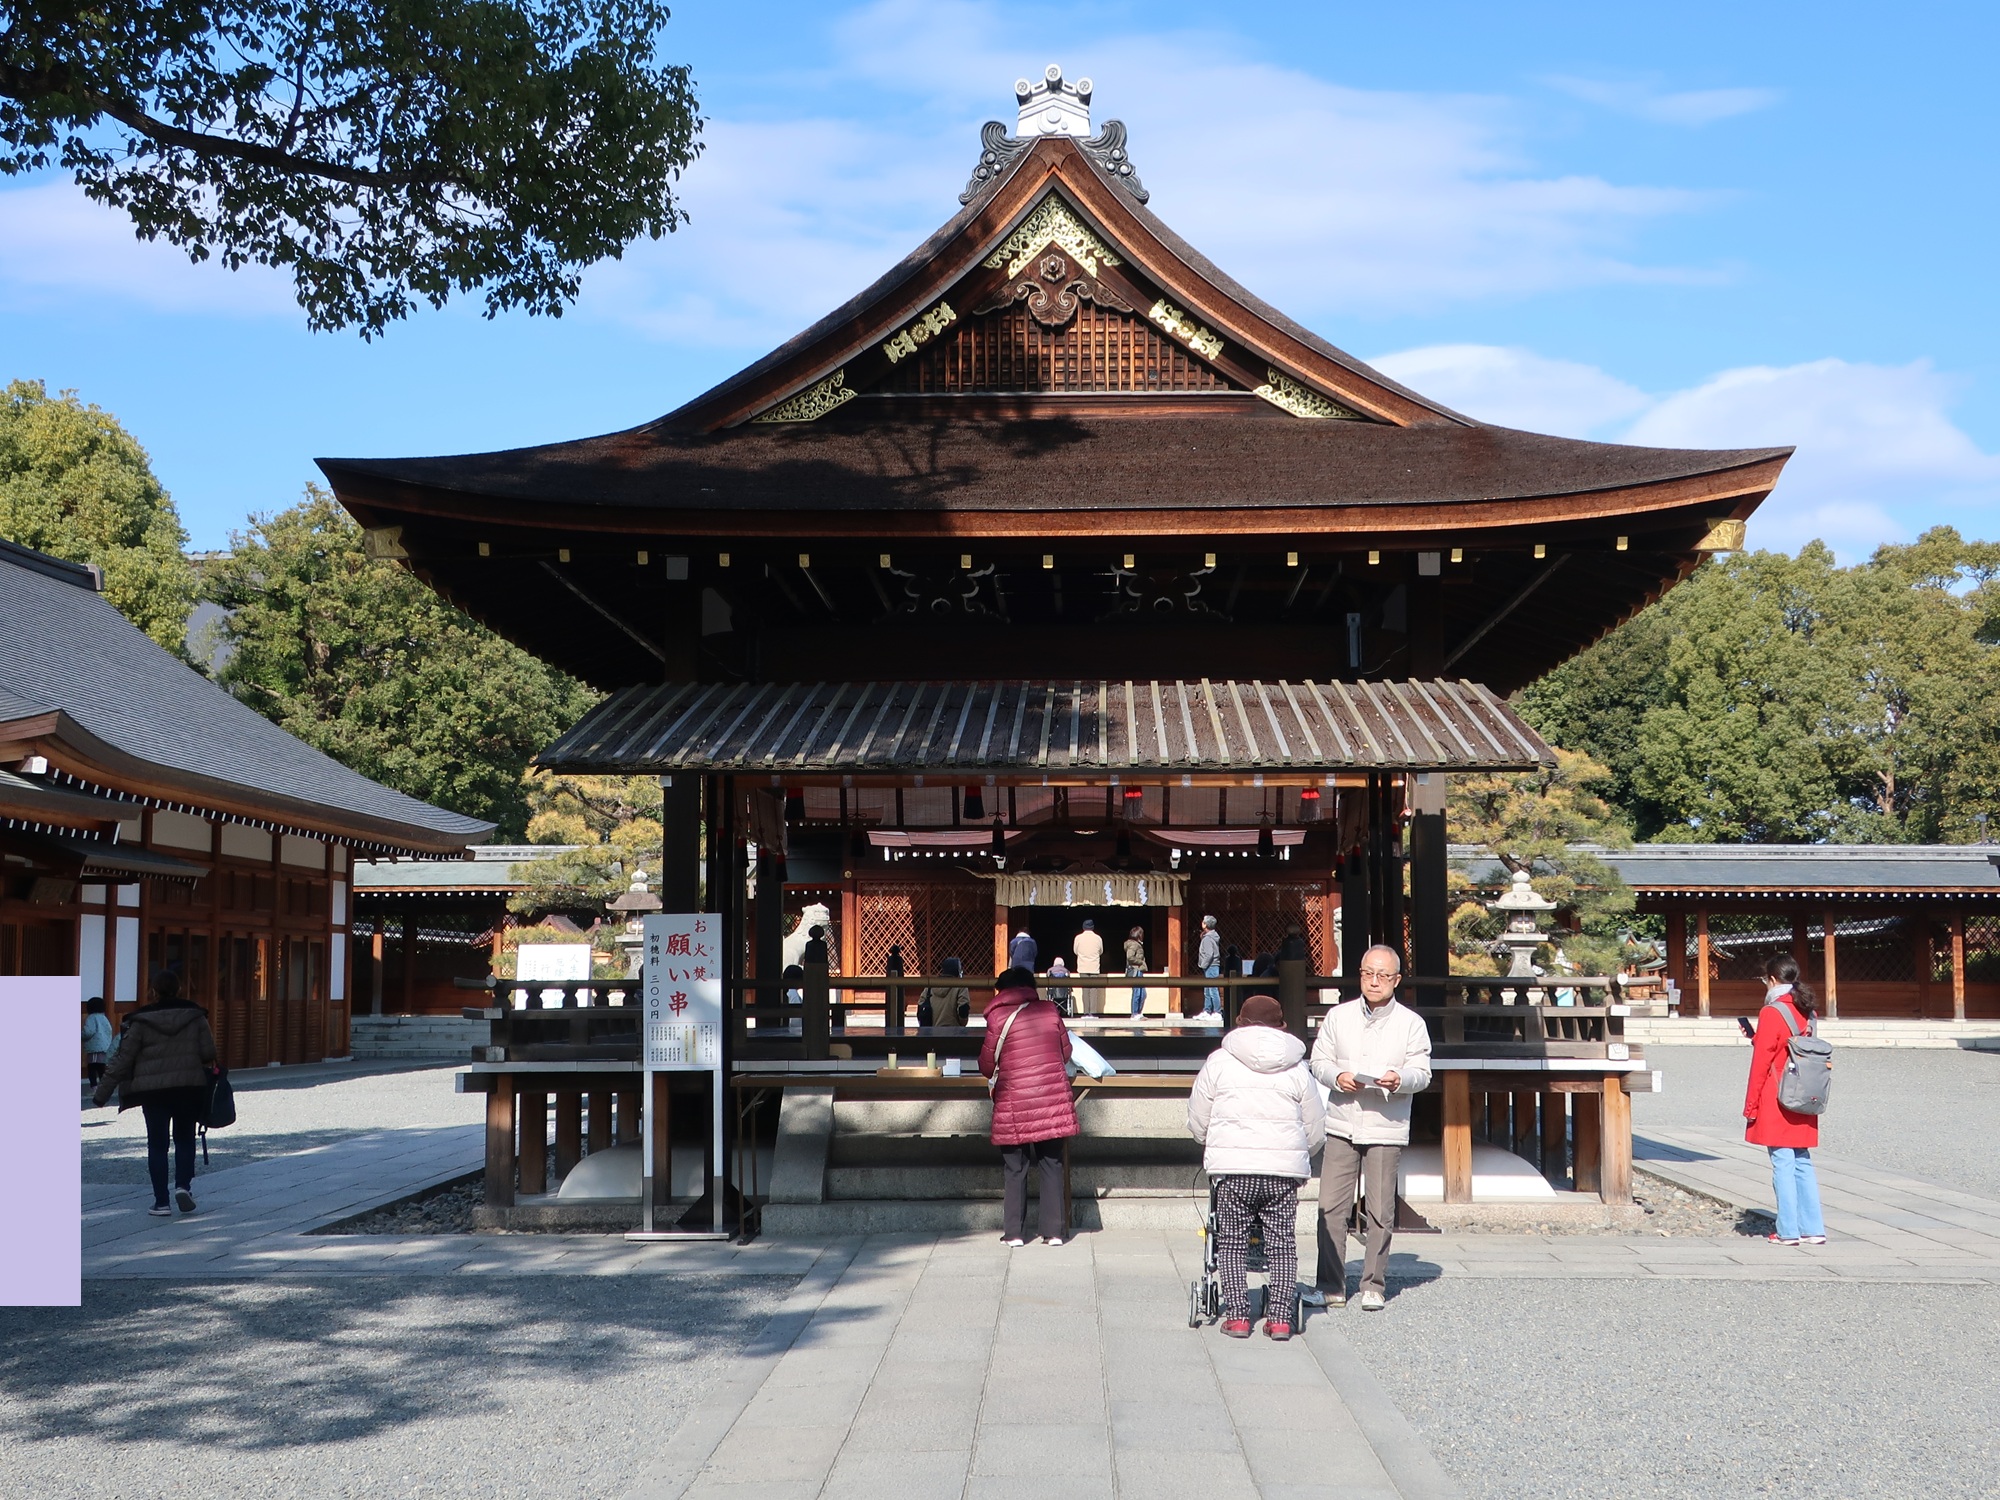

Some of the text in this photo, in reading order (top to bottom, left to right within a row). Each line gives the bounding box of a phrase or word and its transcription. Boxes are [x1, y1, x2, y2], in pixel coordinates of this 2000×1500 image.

[649, 933, 660, 1020] 初穂料 三〇〇円
[665, 933, 692, 1018] 願い串
[692, 919, 708, 982] お火焚
